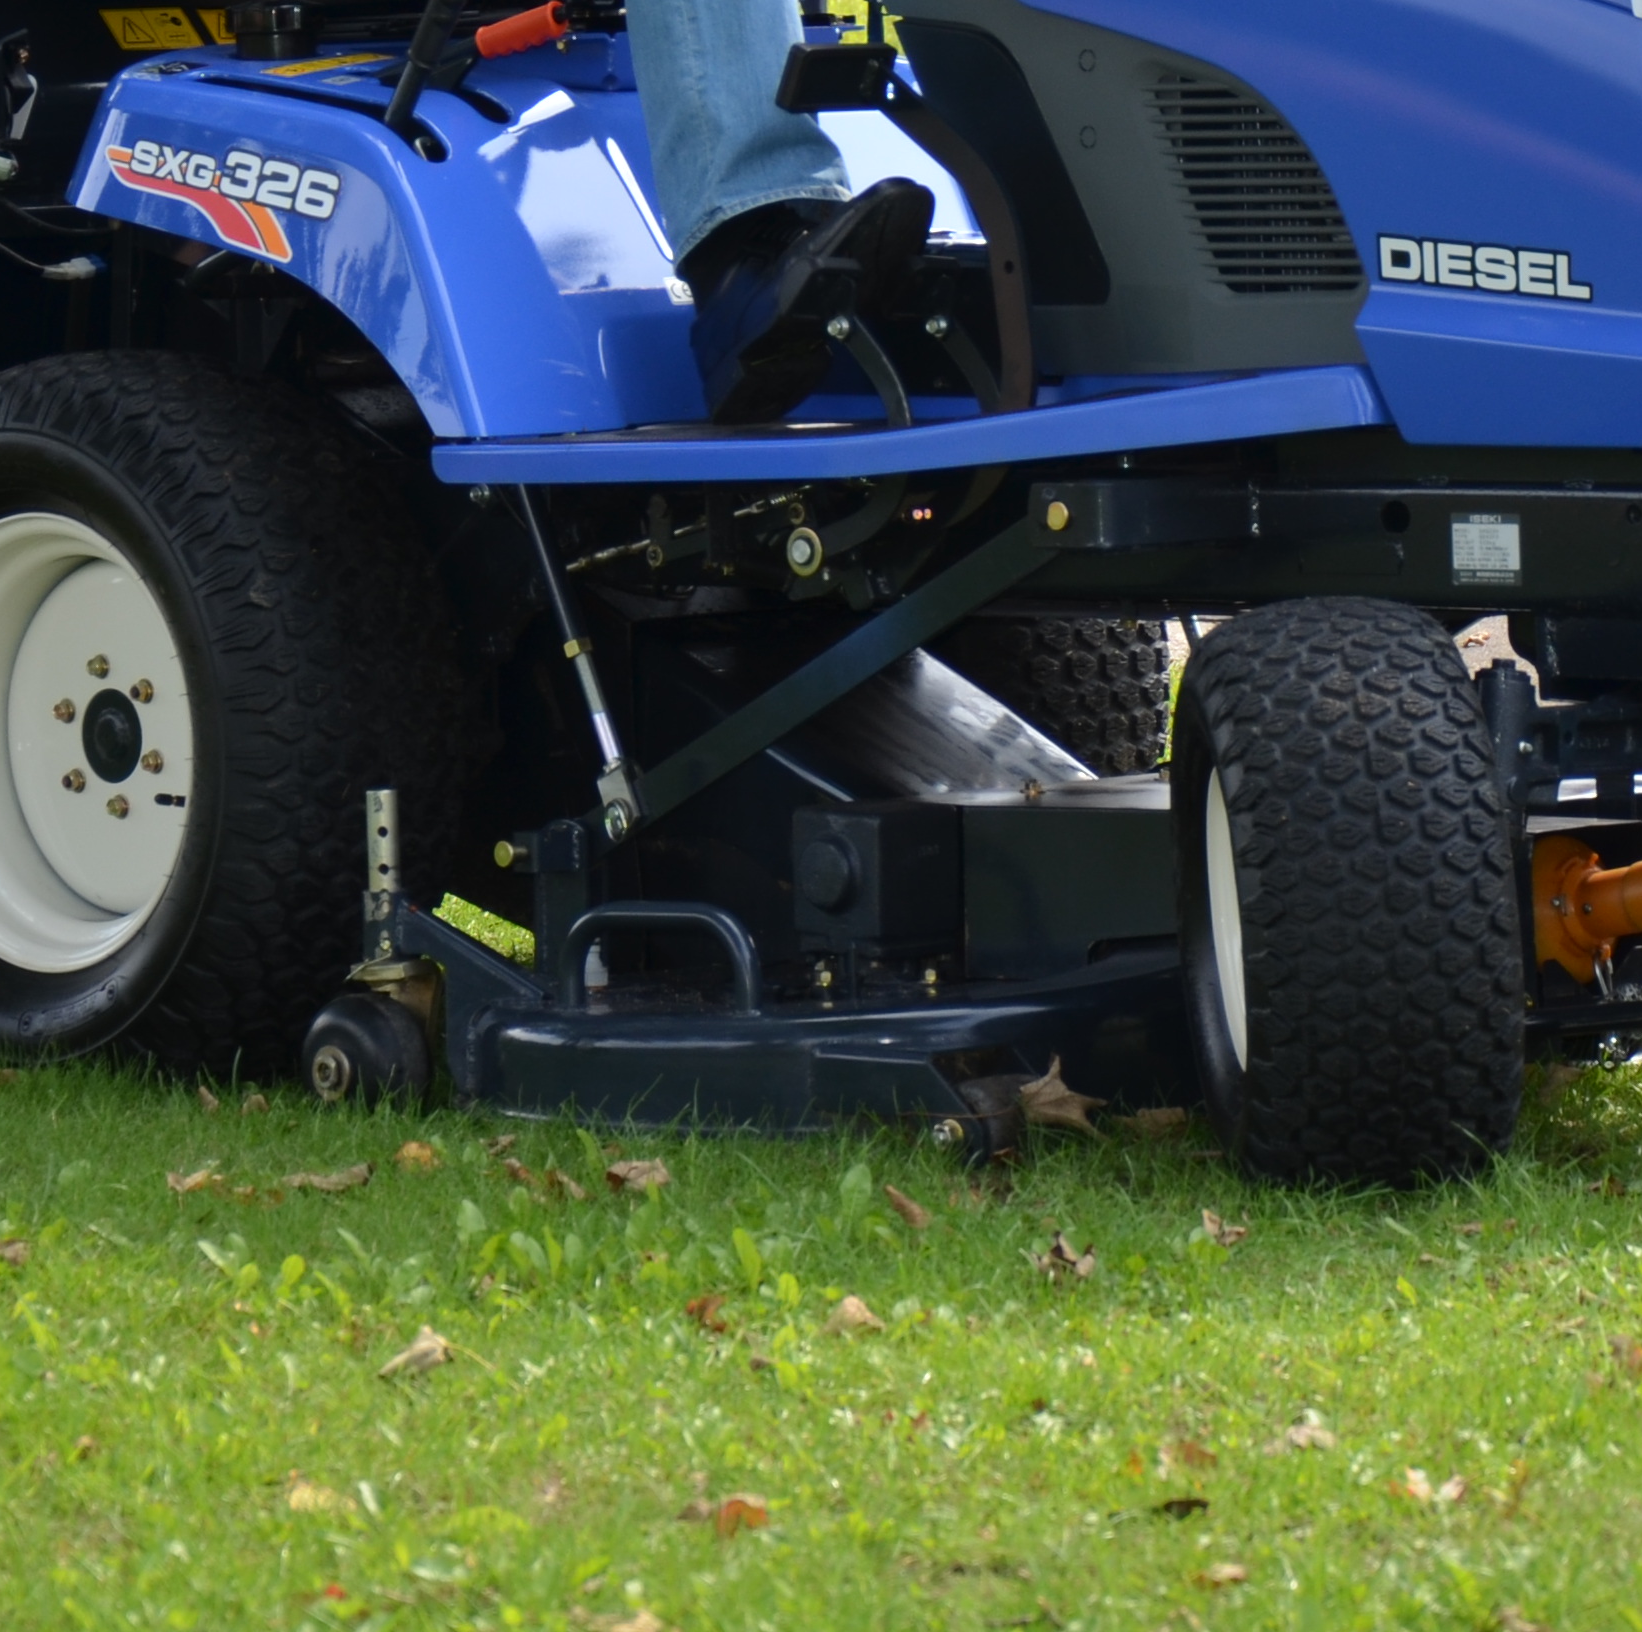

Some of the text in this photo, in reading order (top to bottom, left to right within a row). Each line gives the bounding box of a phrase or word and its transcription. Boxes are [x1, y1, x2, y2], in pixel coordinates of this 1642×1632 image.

[129, 140, 340, 220] SXG 326
[1379, 236, 1591, 300] DIESEL
[1469, 514, 1502, 524] ISEKI
